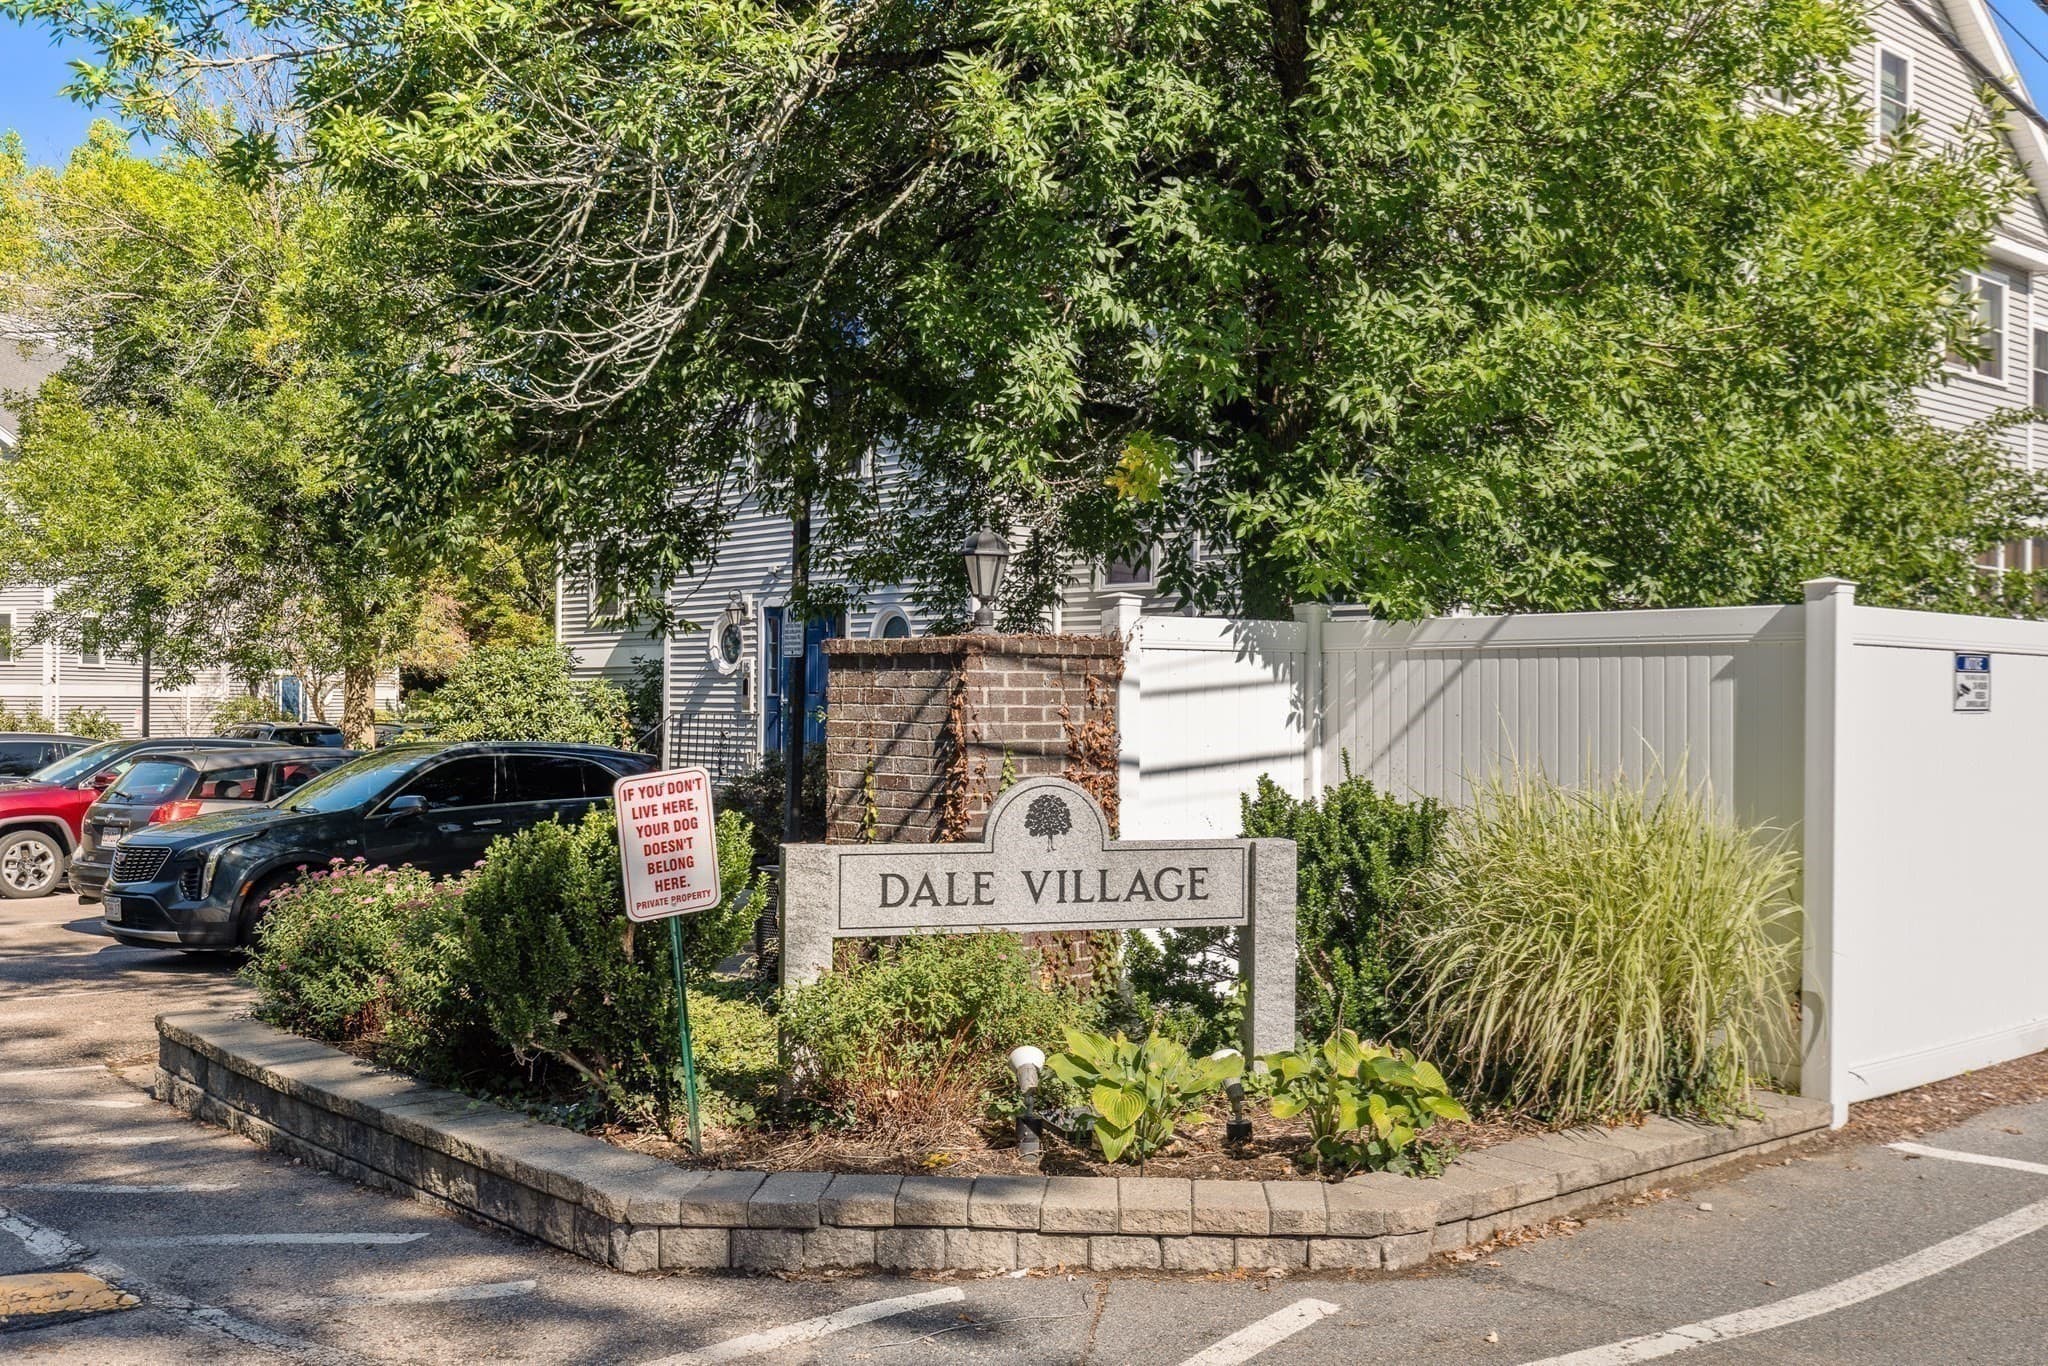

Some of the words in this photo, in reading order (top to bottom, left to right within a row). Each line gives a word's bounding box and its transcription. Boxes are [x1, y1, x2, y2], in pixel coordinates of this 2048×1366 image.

[623, 789, 634, 801] IF
[638, 784, 662, 799] YOU
[668, 778, 702, 795] DON'T
[632, 804, 658, 820] LIVE
[663, 799, 698, 815] HERE,
[636, 822, 669, 838] YOUR
[674, 817, 698, 832] DOG
[644, 837, 694, 856] DOESN'T
[648, 856, 694, 875] BELONG
[655, 876, 690, 893] HERE.
[878, 870, 995, 908] DALE
[1021, 866, 1209, 905] VILLAGE
[636, 896, 669, 911] PRIVATE
[671, 889, 712, 904] PROPERTY
